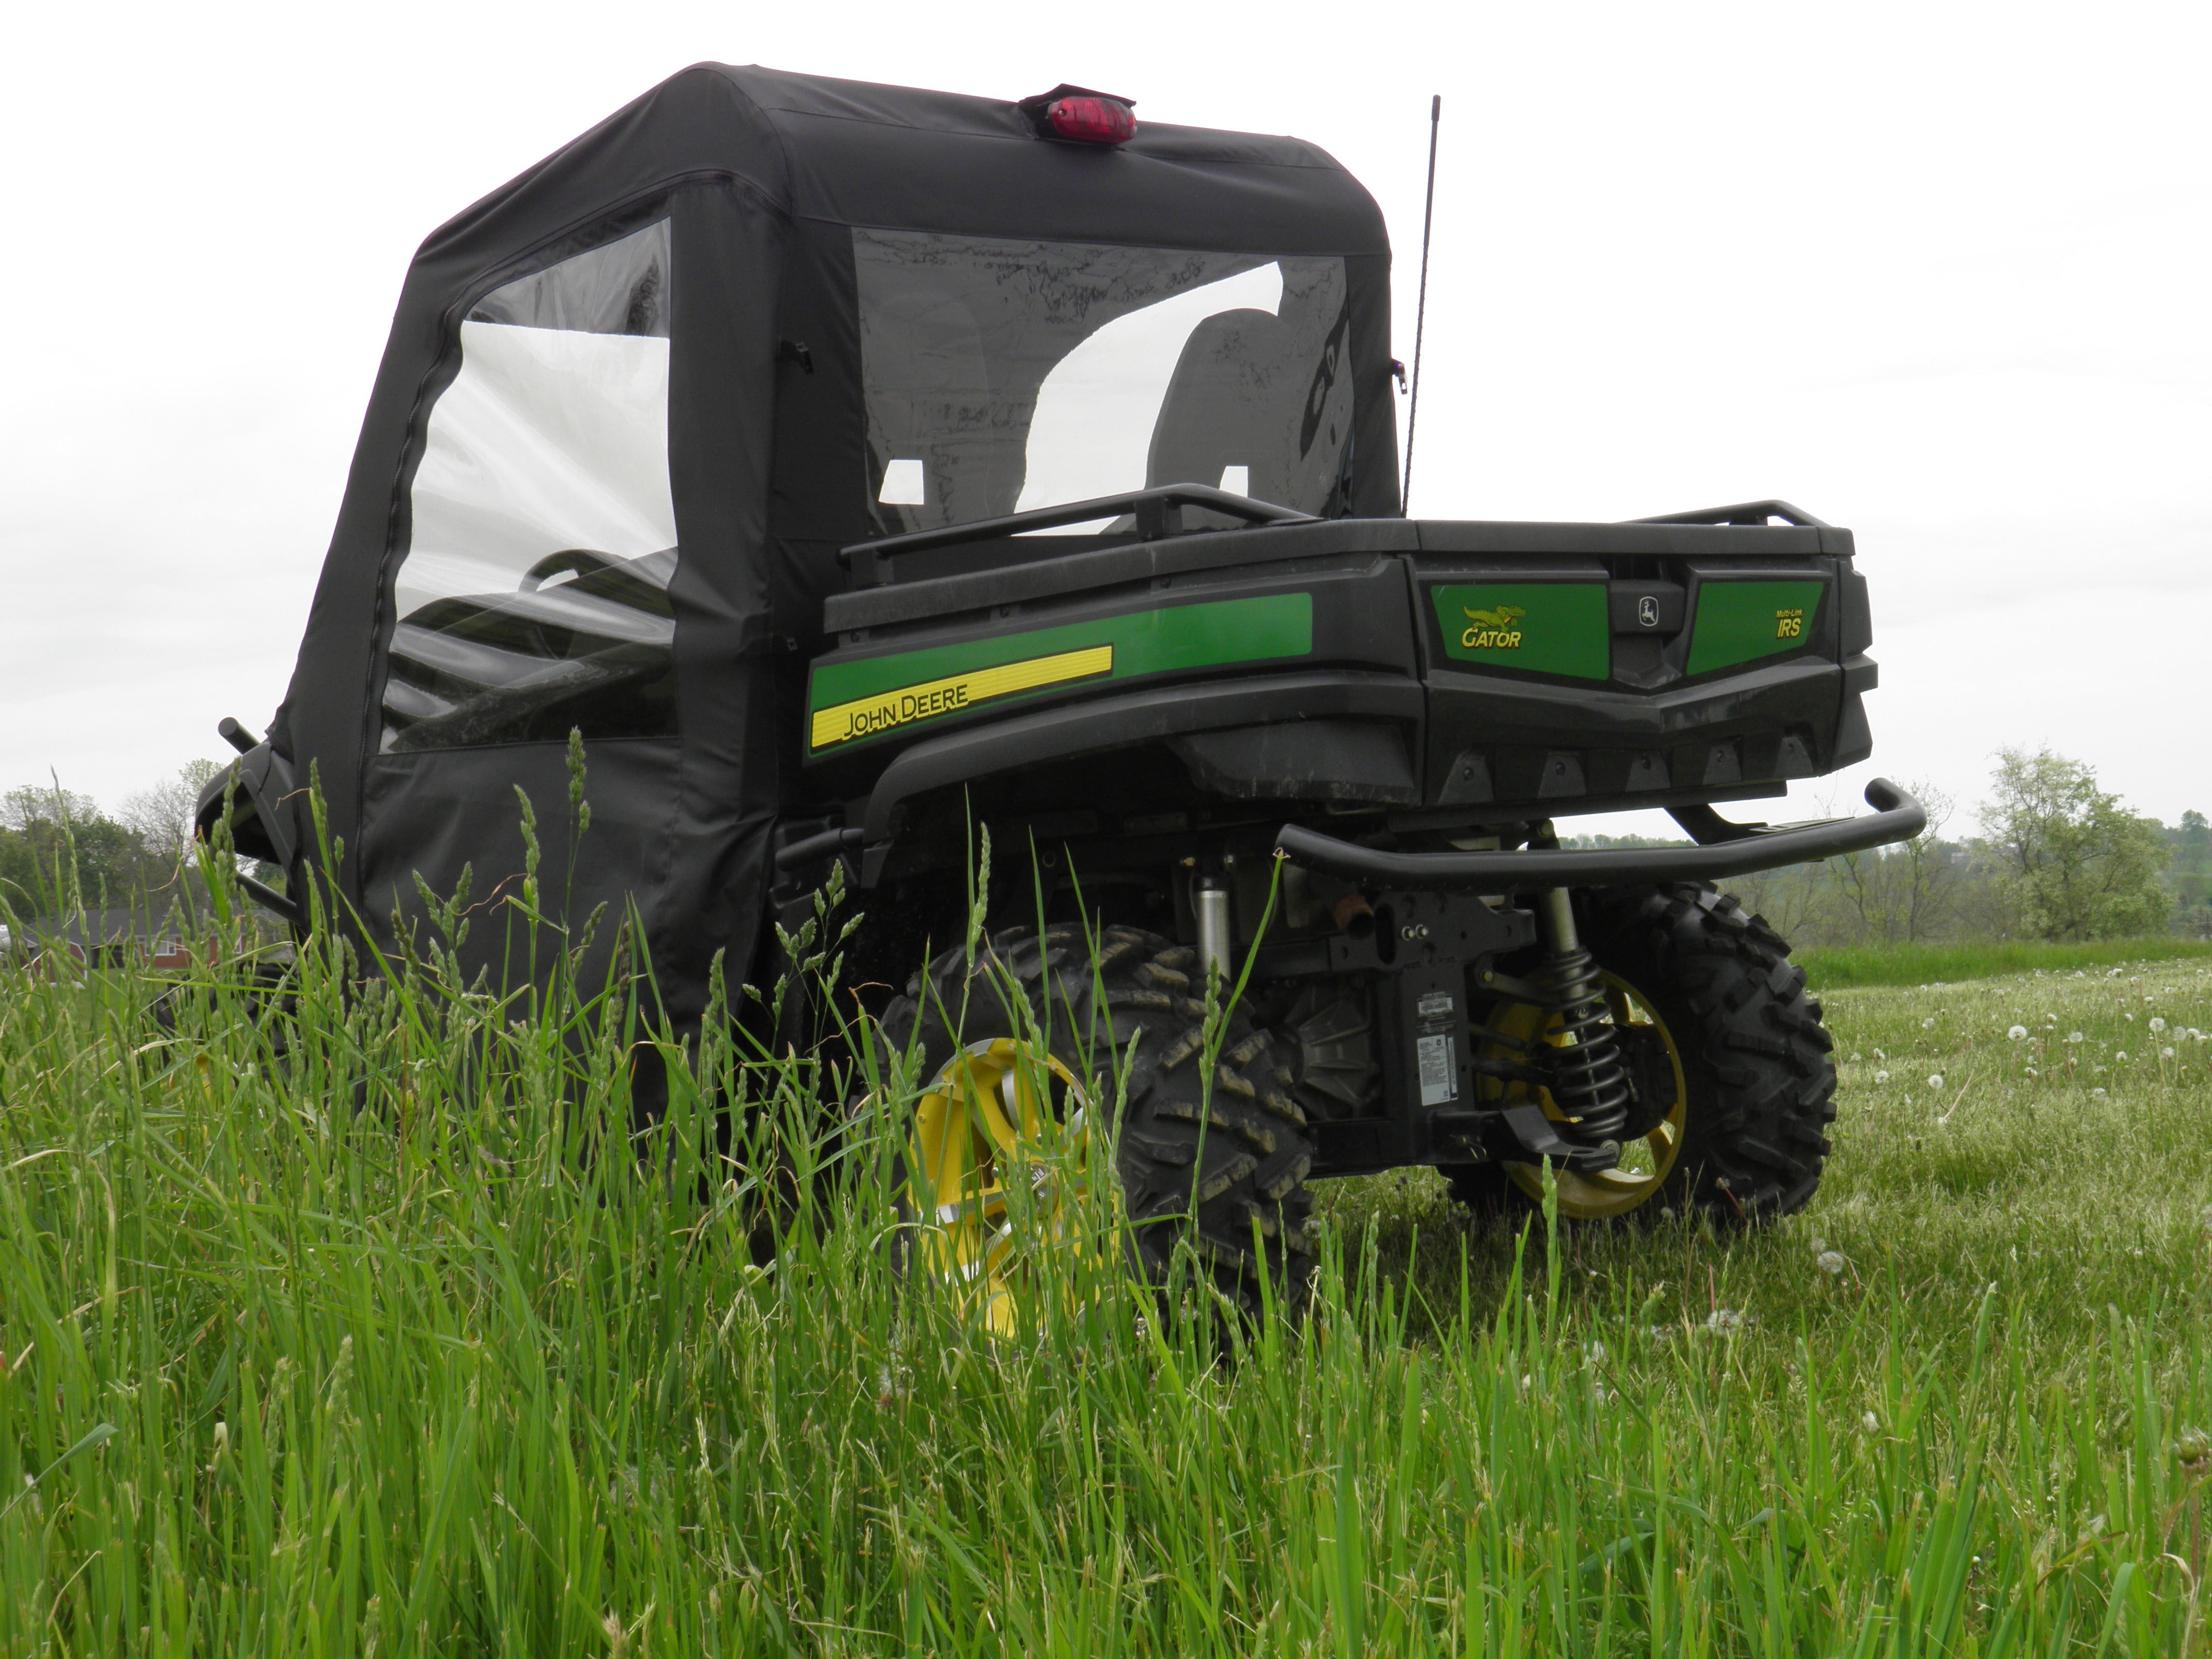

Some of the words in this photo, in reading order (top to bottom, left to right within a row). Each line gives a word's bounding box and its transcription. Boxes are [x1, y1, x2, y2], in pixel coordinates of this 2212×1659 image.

[1462, 628, 1521, 648] GATOR
[1778, 618, 1801, 638] IRS
[843, 704, 896, 737] JOHN
[901, 684, 968, 719] DEERE
